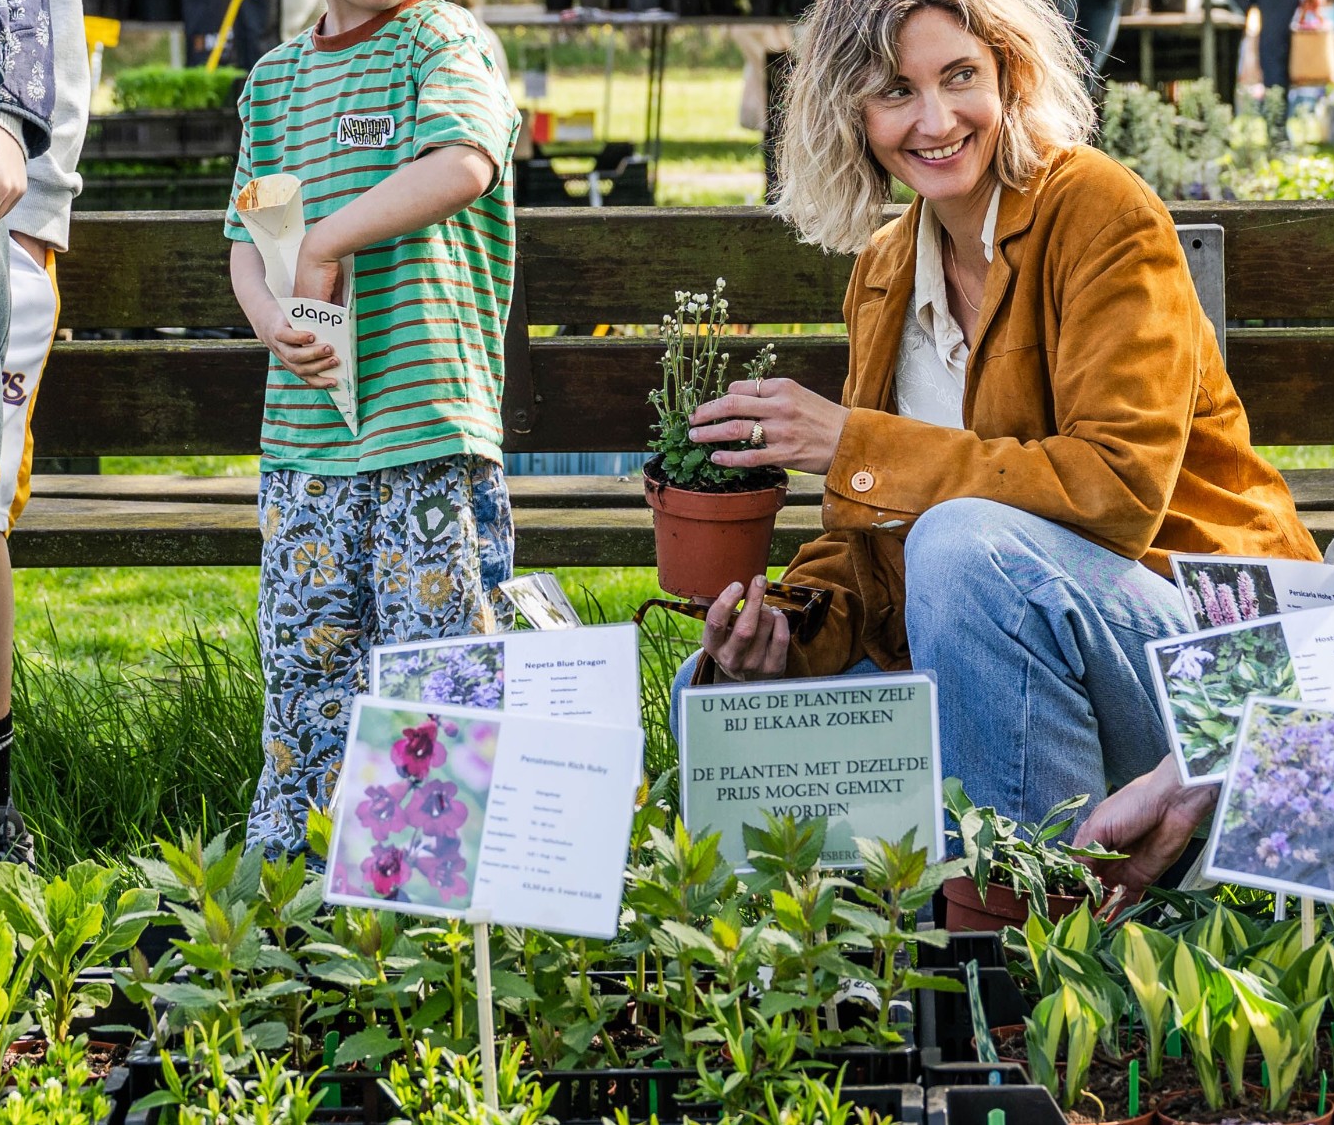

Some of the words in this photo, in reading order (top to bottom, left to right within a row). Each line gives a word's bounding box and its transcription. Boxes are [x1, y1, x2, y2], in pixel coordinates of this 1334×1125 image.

[291, 303, 343, 327] dapp
[1288, 589, 1317, 599] Persicaria
[525, 661, 555, 670] Nepeta
[576, 658, 607, 667] Dragon
[701, 699, 714, 712] U
[720, 695, 761, 711] MAG
[767, 694, 789, 708] DE
[794, 690, 872, 707] PLANTEN
[878, 687, 916, 702] ZELF
[724, 718, 748, 732] BIJ
[754, 713, 821, 730] ELKAAR
[826, 709, 894, 726] ZOEKEN
[692, 767, 715, 782] DE
[720, 763, 799, 781] PLANTEN
[805, 761, 841, 776] MET
[846, 756, 929, 774] DEZELFDE
[717, 786, 760, 802] PRIJS
[765, 782, 830, 799] MOGEN
[835, 778, 904, 796] GEMIXT
[772, 802, 850, 819] WORDEN
[821, 849, 861, 861] ESBERG
